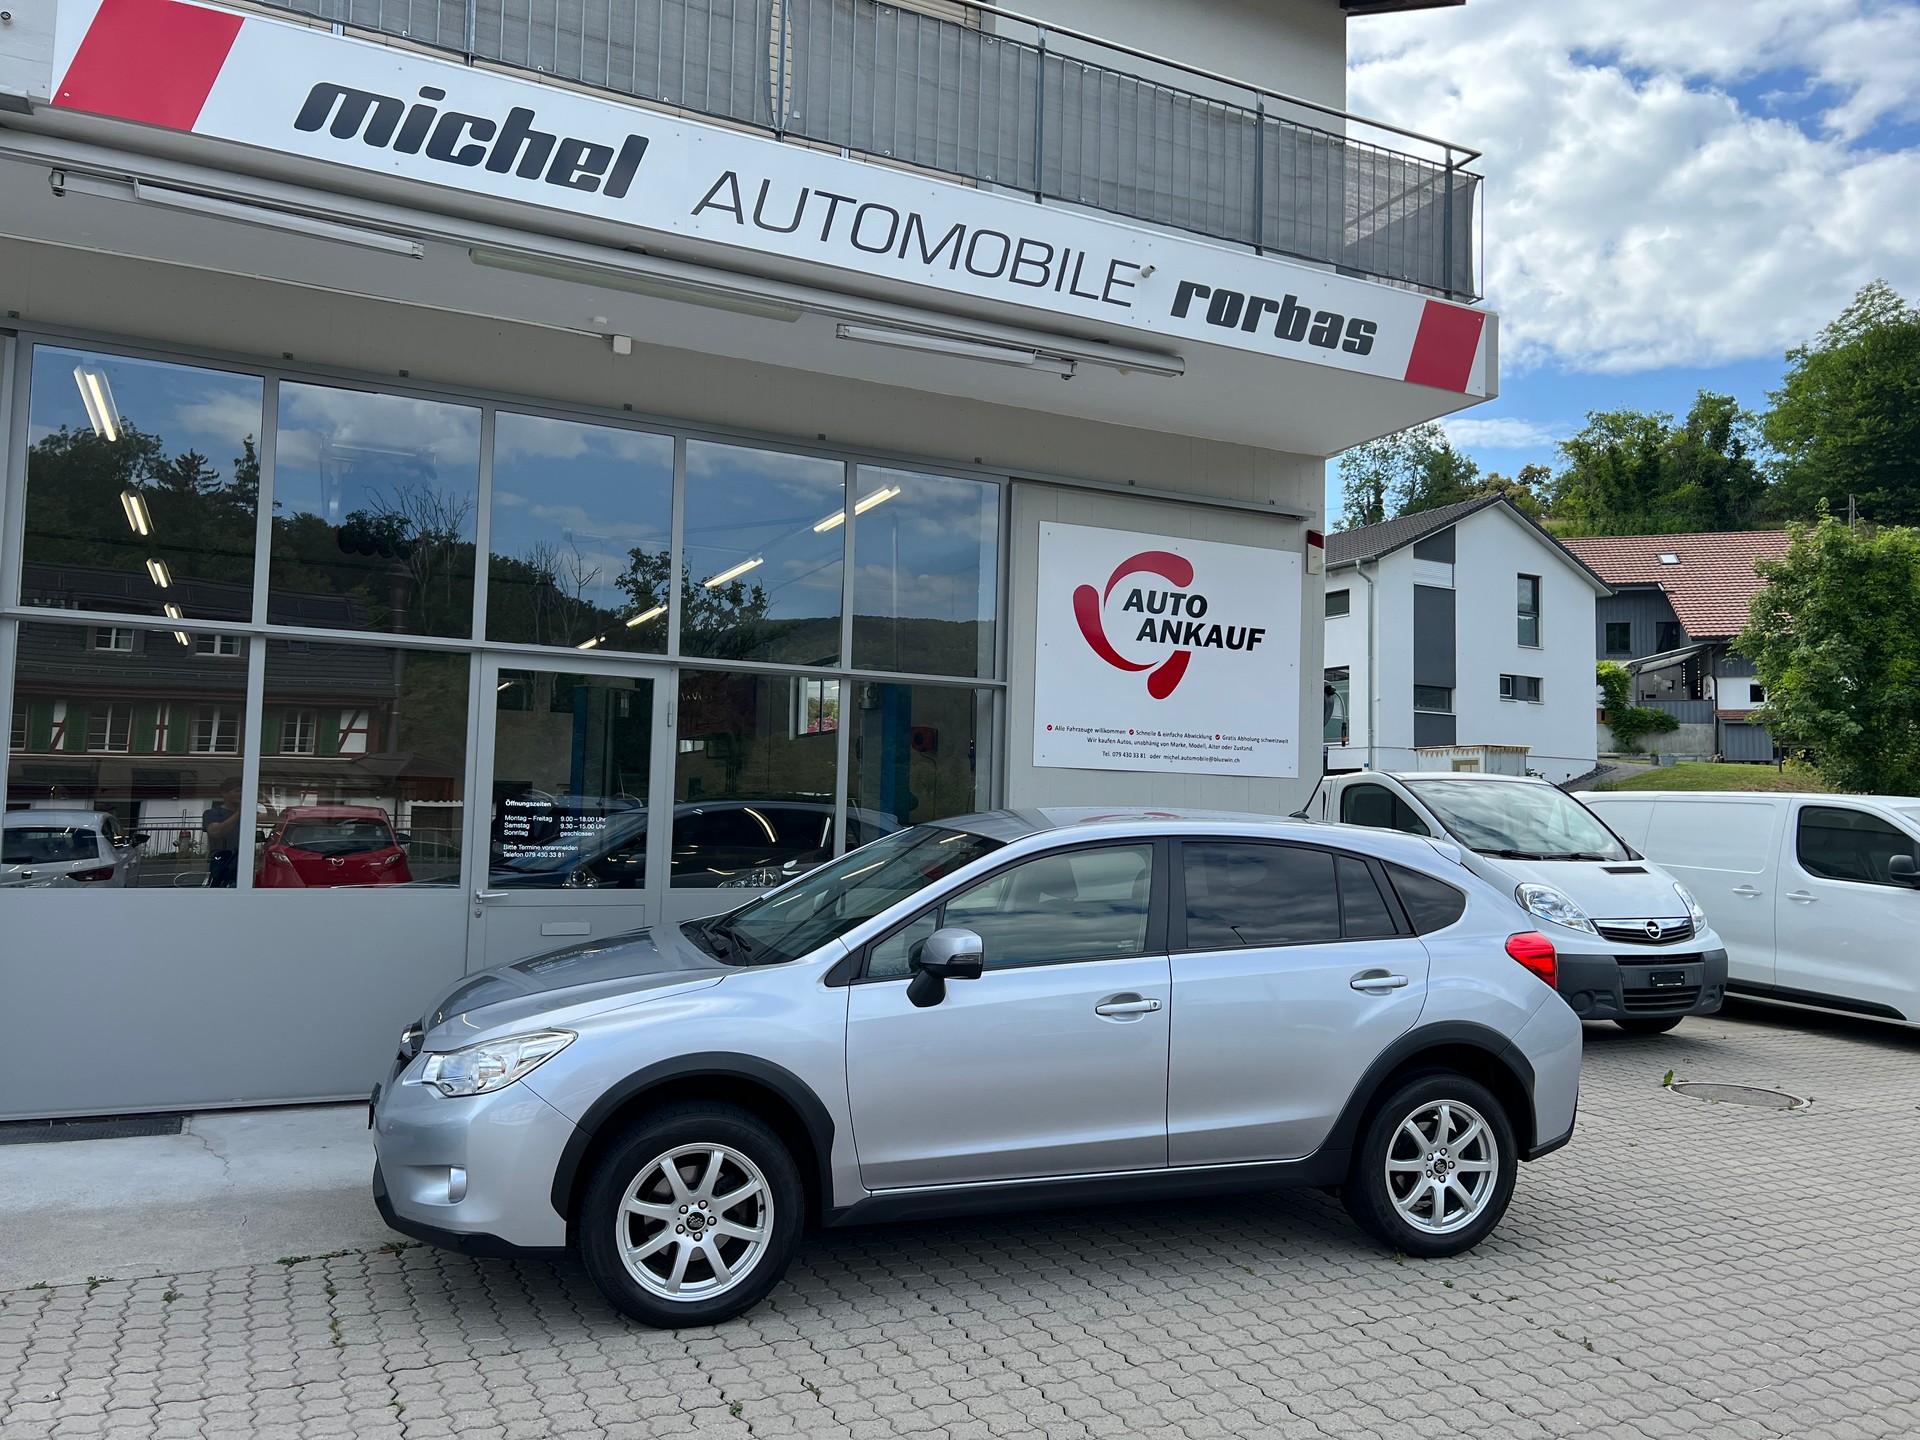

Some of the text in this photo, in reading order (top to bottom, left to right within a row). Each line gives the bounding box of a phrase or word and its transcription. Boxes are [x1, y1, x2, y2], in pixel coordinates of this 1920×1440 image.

[293, 81, 1378, 356] michel AUTOMOBILE rorbas
[1122, 588, 1208, 618] AUTO
[1136, 618, 1266, 651] ANKAUF
[1067, 726, 1093, 734] Fahrzeuge
[1094, 727, 1126, 735] willkommen
[1184, 732, 1212, 740] Abwicklung
[505, 799, 552, 808] Öffnungszeiten
[533, 815, 553, 823] Freitag
[504, 822, 530, 830] Samstag
[504, 829, 529, 837] Sonntag
